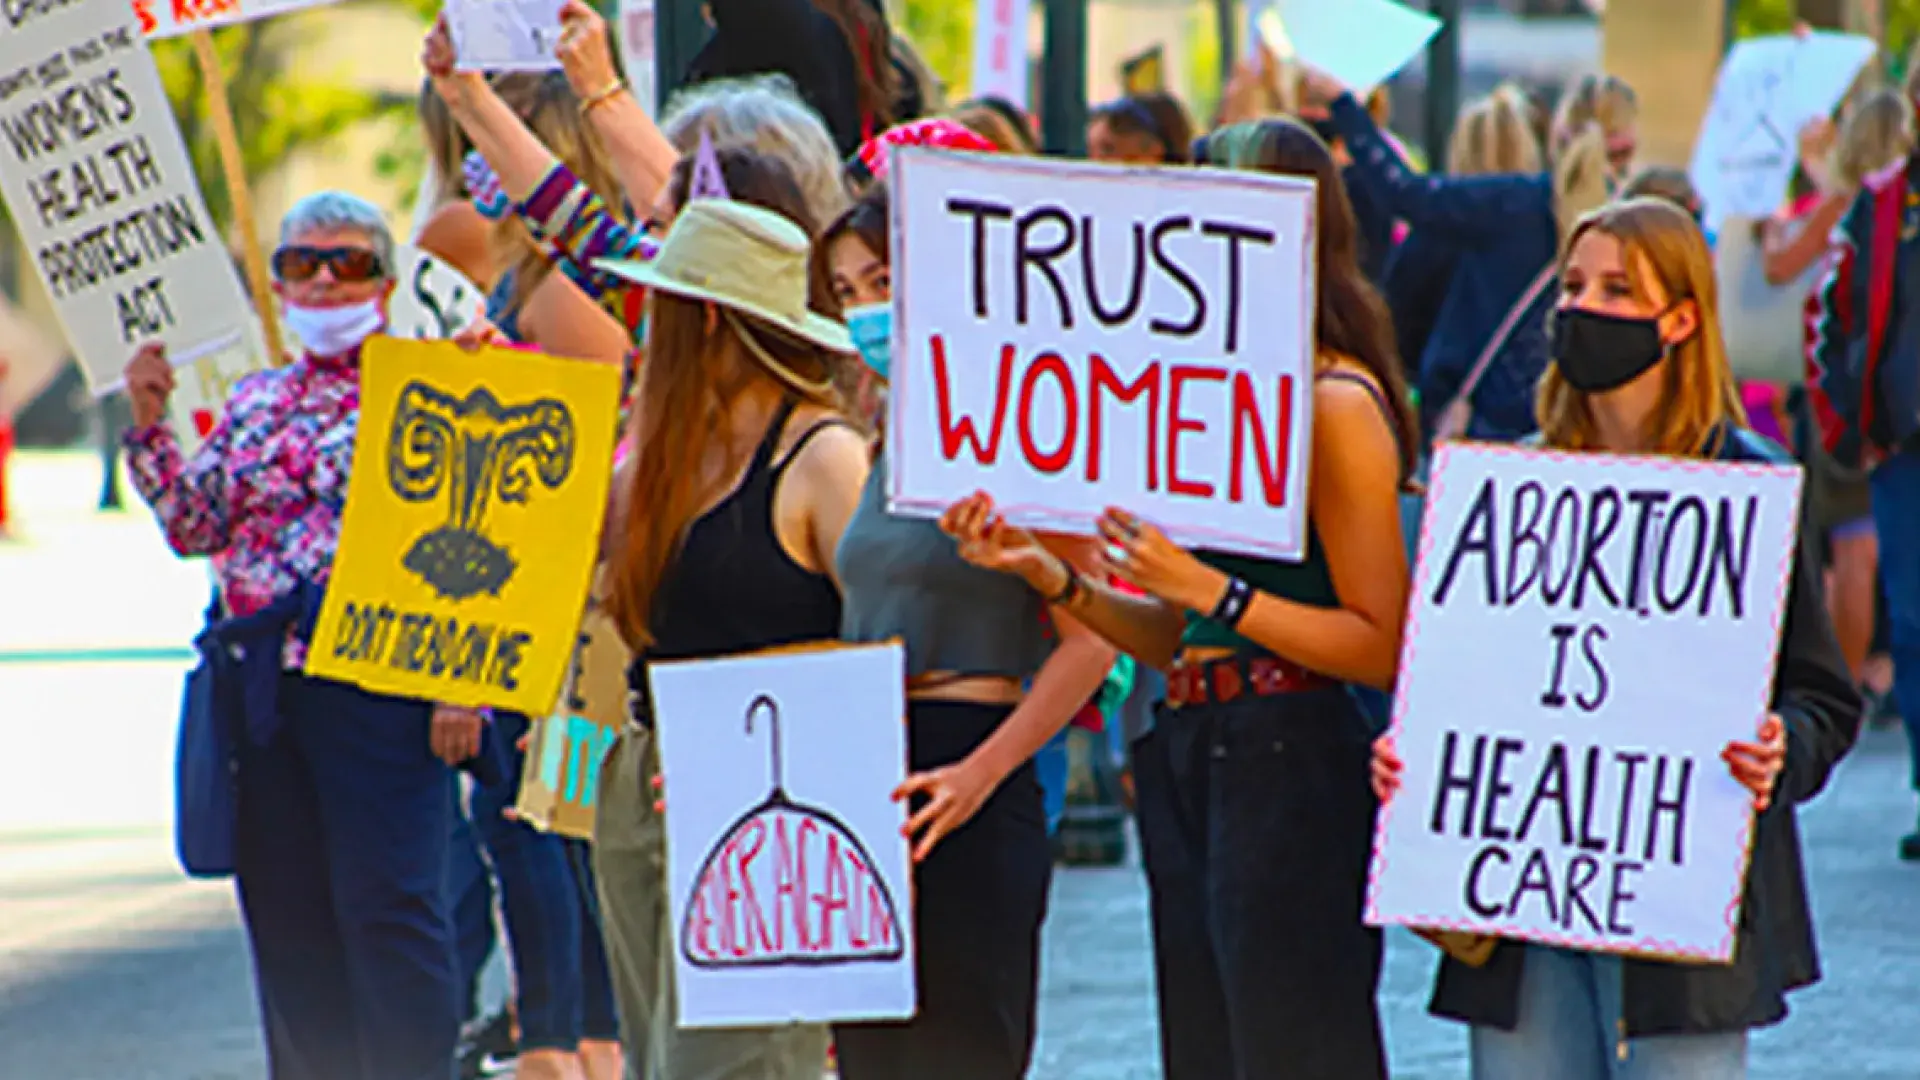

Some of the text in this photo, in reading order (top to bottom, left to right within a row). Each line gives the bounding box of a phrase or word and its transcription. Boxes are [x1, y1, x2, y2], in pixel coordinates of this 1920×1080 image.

[27, 134, 162, 228] HEALTH
[39, 194, 206, 298] PROTECTION
[946, 198, 1276, 353] TRUST
[115, 276, 176, 343] ACT
[929, 334, 1294, 507] WOMEN
[1432, 478, 1758, 619] ABORTION
[1540, 624, 1609, 712] IS
[1430, 731, 1694, 866] HEALTH
[1464, 845, 1644, 935] CARE
